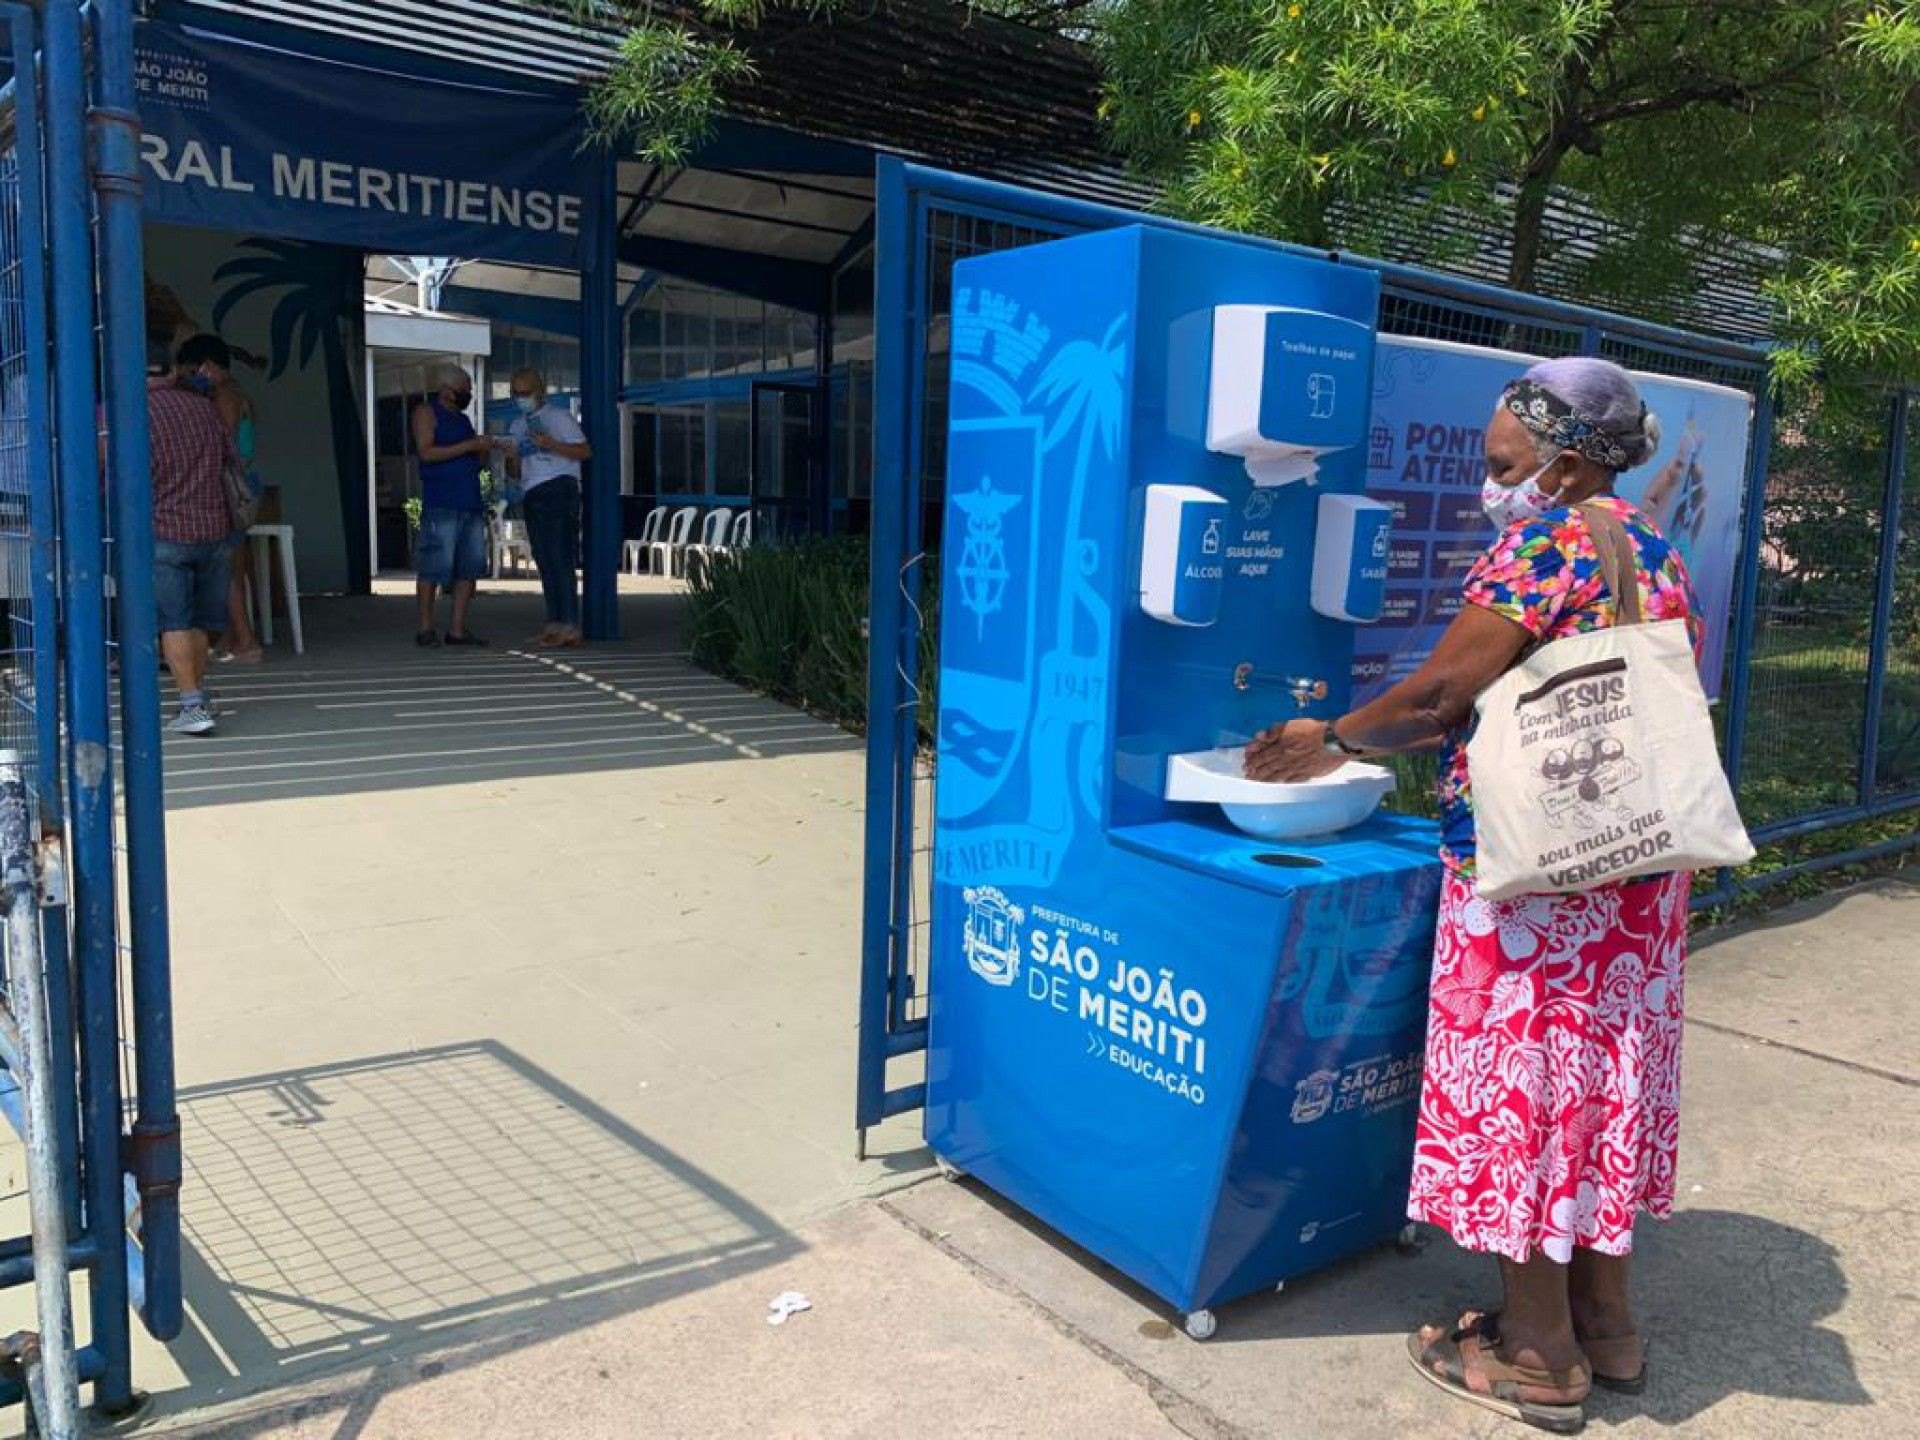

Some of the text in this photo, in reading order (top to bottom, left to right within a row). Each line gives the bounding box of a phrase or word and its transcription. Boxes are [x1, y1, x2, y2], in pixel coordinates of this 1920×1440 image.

[272, 153, 582, 236] MERITIENSE
[1243, 530, 1271, 542] LAVE
[1555, 676, 1626, 718] JESUS
[1594, 704, 1634, 725] vida
[1537, 809, 1666, 869] sou mais que
[1546, 830, 1674, 888] VENCEDOR
[1032, 904, 1121, 946] PREFEITURA DE
[1030, 927, 1207, 1027] SÃO JOÃO
[1028, 966, 1206, 1075] DE MERITI
[1108, 1044, 1206, 1105] EDUCAÇÃO
[1340, 1065, 1380, 1092] SÃO
